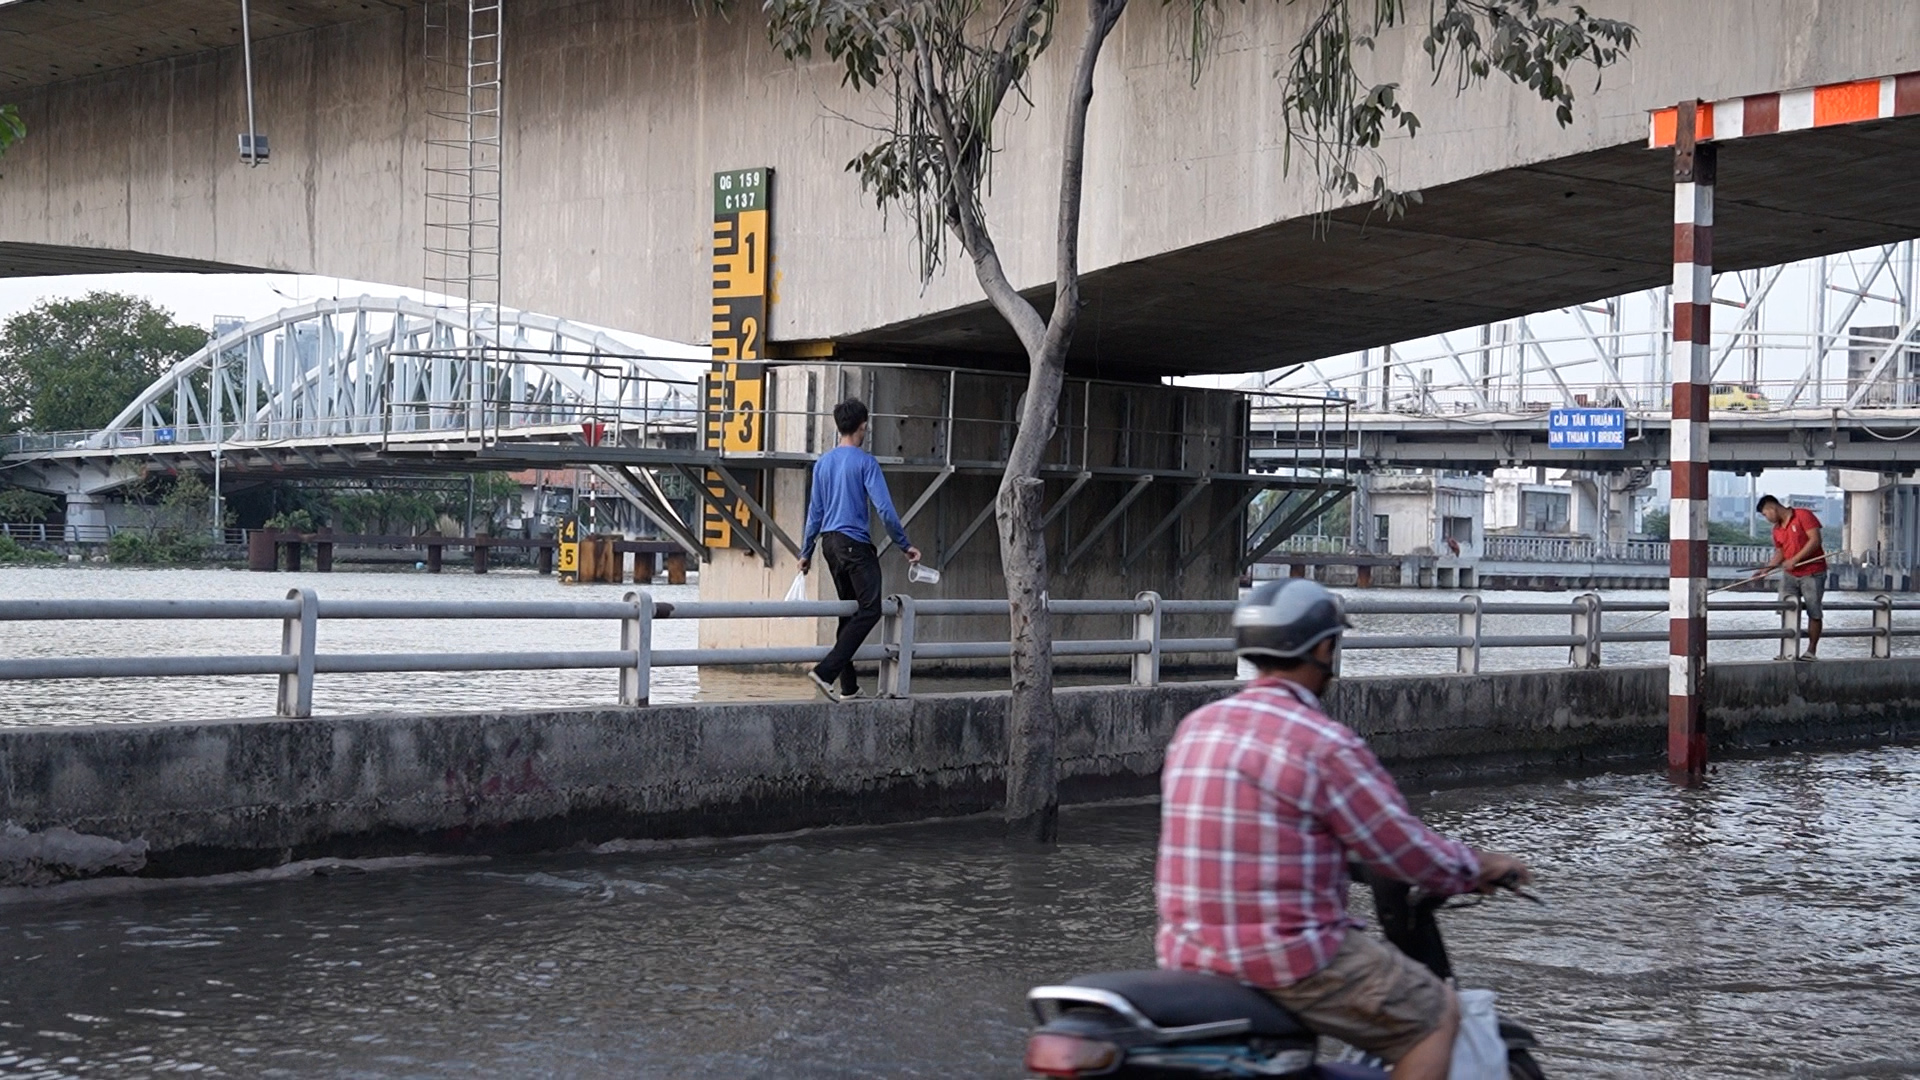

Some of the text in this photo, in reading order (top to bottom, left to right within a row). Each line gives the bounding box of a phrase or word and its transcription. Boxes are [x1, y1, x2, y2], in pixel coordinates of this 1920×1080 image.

[720, 171, 760, 190] QG 159
[745, 232, 754, 274] 1
[741, 316, 757, 360] 2
[739, 400, 753, 443] 3
[1616, 414, 1621, 427] 1
[1592, 431, 1596, 443] 1
[1598, 431, 1623, 443] BRIDGE
[735, 485, 751, 527] 4
[565, 521, 575, 539] 4
[565, 549, 574, 565] 5
